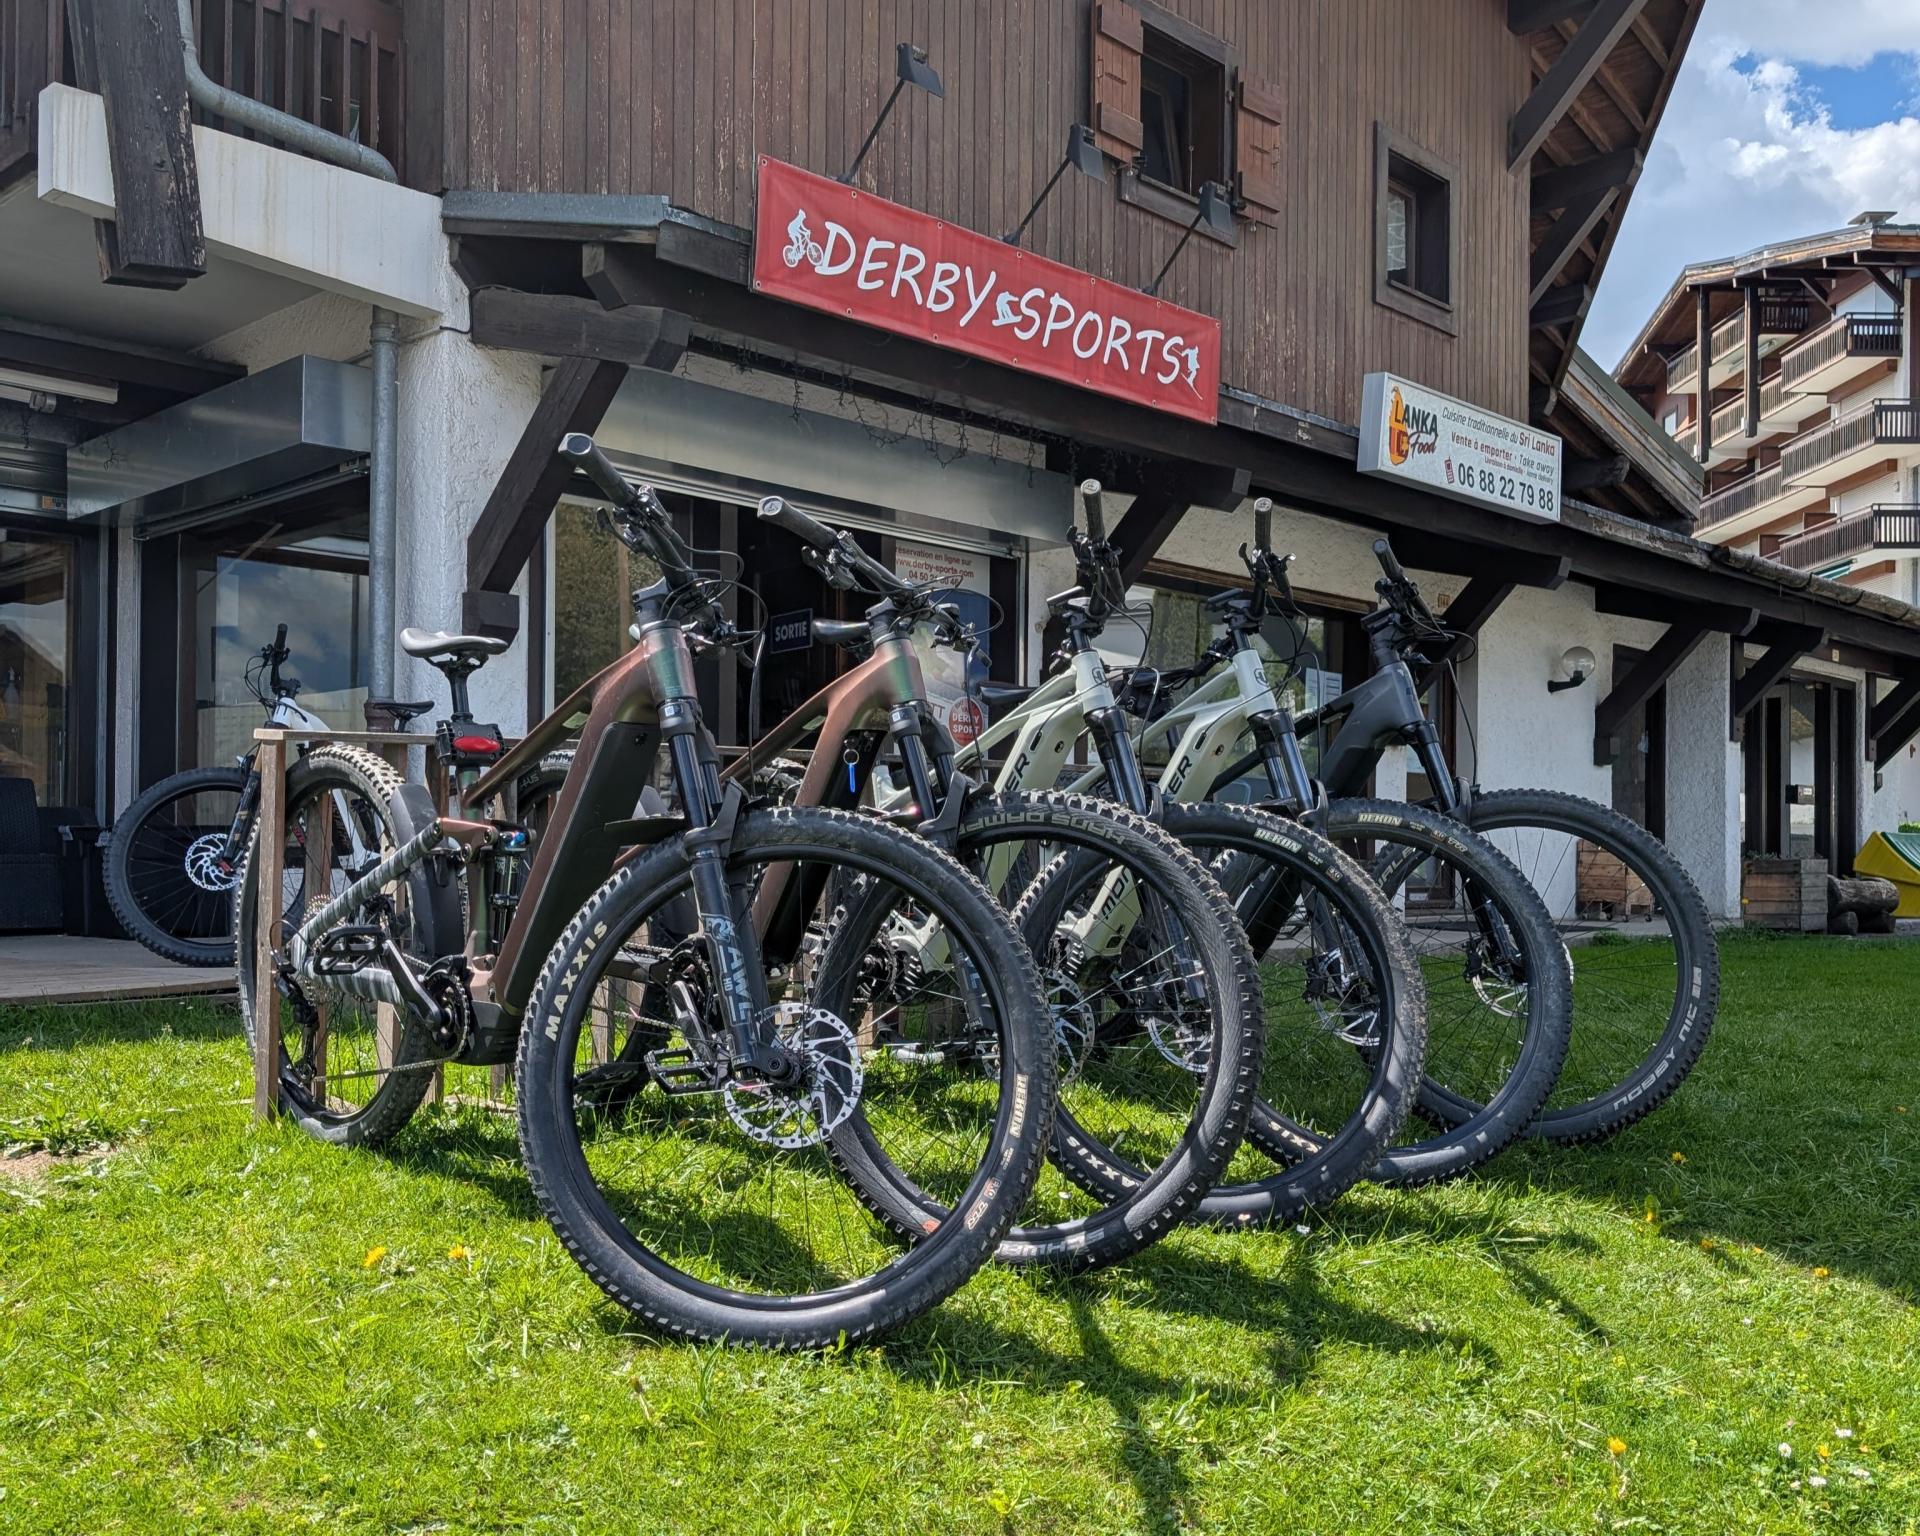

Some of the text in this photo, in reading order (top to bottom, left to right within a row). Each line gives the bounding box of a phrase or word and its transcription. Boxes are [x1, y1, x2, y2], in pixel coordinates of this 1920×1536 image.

[814, 221, 1185, 384] DERBY SPORTS
[1395, 400, 1438, 435] LANKA
[1442, 407, 1555, 456] Cuisine traditionnelle du Sri Lanka
[1408, 431, 1439, 459] Food
[1451, 431, 1472, 448] Vente
[1480, 443, 1513, 462] emporter
[1519, 454, 1535, 469] Take
[1536, 462, 1554, 477] away
[1458, 462, 1554, 512] 06 88 22 79 88
[775, 621, 807, 641] SORTIE
[1254, 828, 1303, 854] REKON
[1358, 813, 1402, 826] REKON
[545, 921, 607, 1041] MAXXIS
[722, 977, 734, 991] HD
[728, 947, 754, 1021] AWL
[1613, 1003, 1698, 1111] NOBBY NIC
[1010, 1074, 1029, 1138] REKON
[1066, 1135, 1137, 1187] AXXIS
